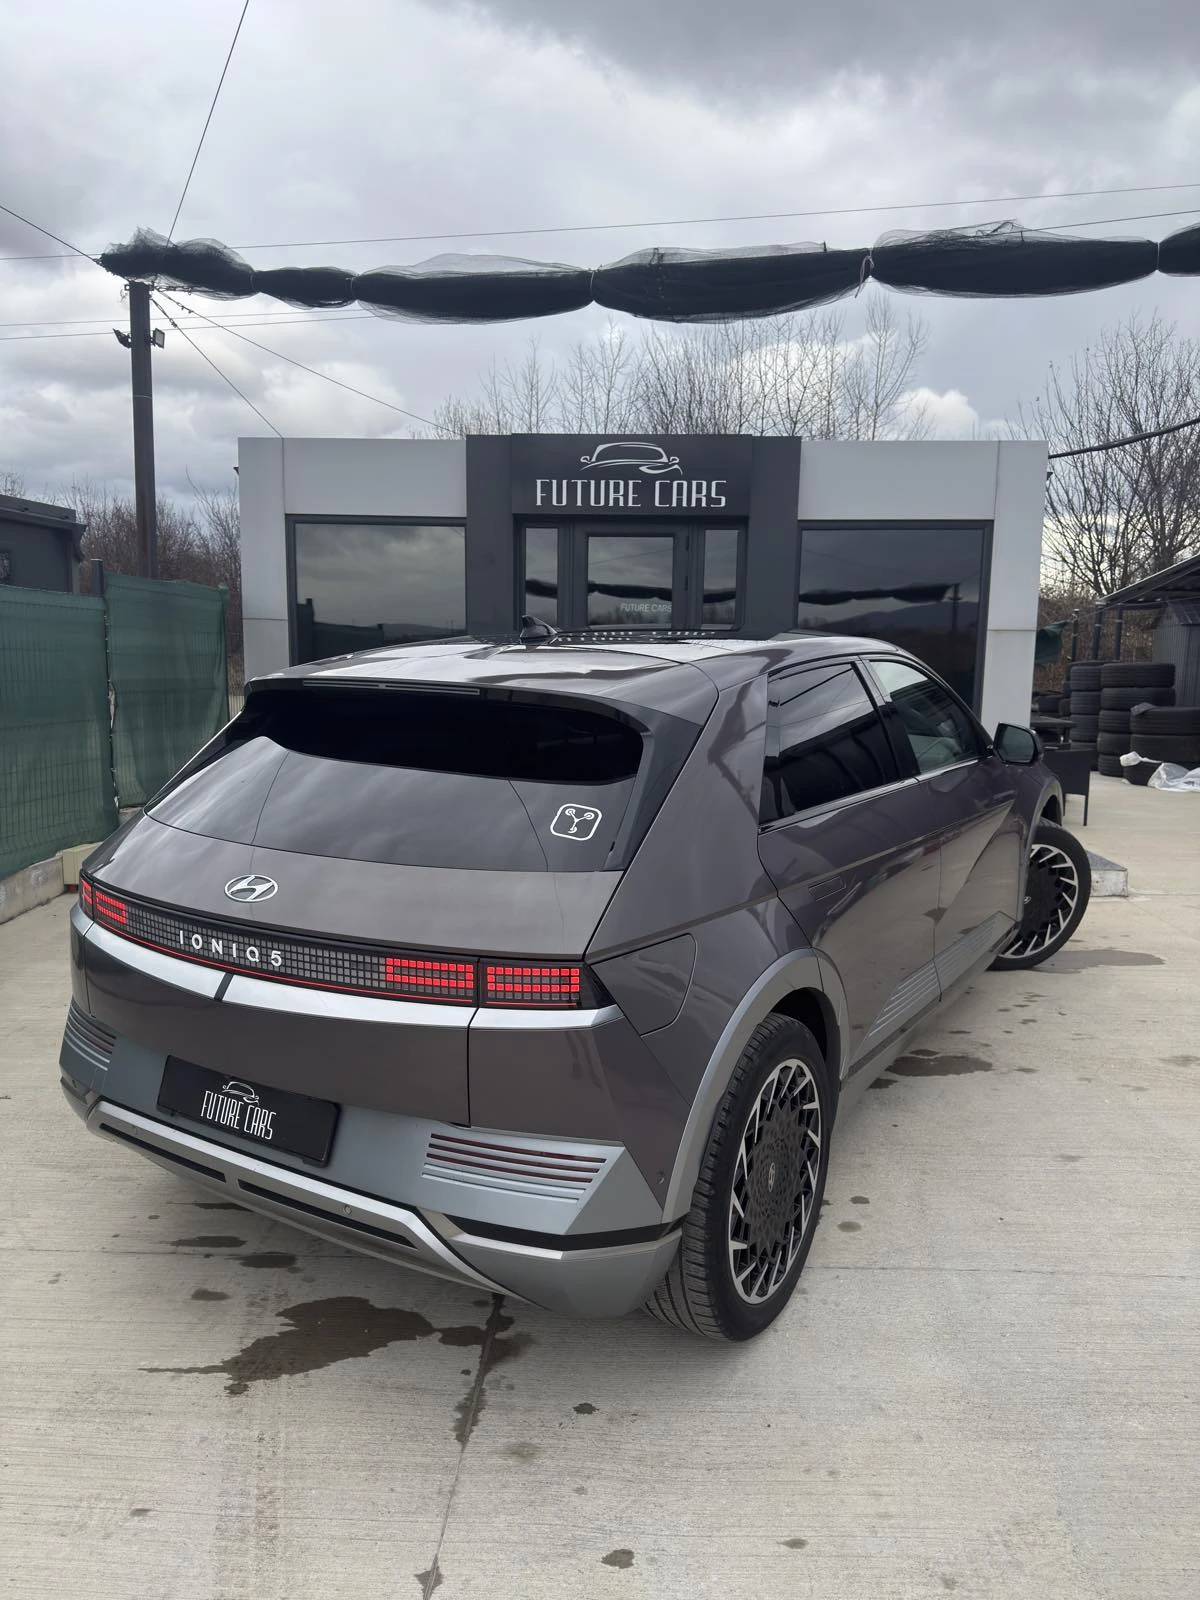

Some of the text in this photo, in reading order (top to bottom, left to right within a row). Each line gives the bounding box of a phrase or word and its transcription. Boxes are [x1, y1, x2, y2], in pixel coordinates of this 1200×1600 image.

[535, 479, 727, 508] FUTURE CARS
[620, 603, 650, 612] FUTURE
[180, 930, 282, 967] IONIQ 5
[201, 1090, 277, 1140] FUTURE CARS
